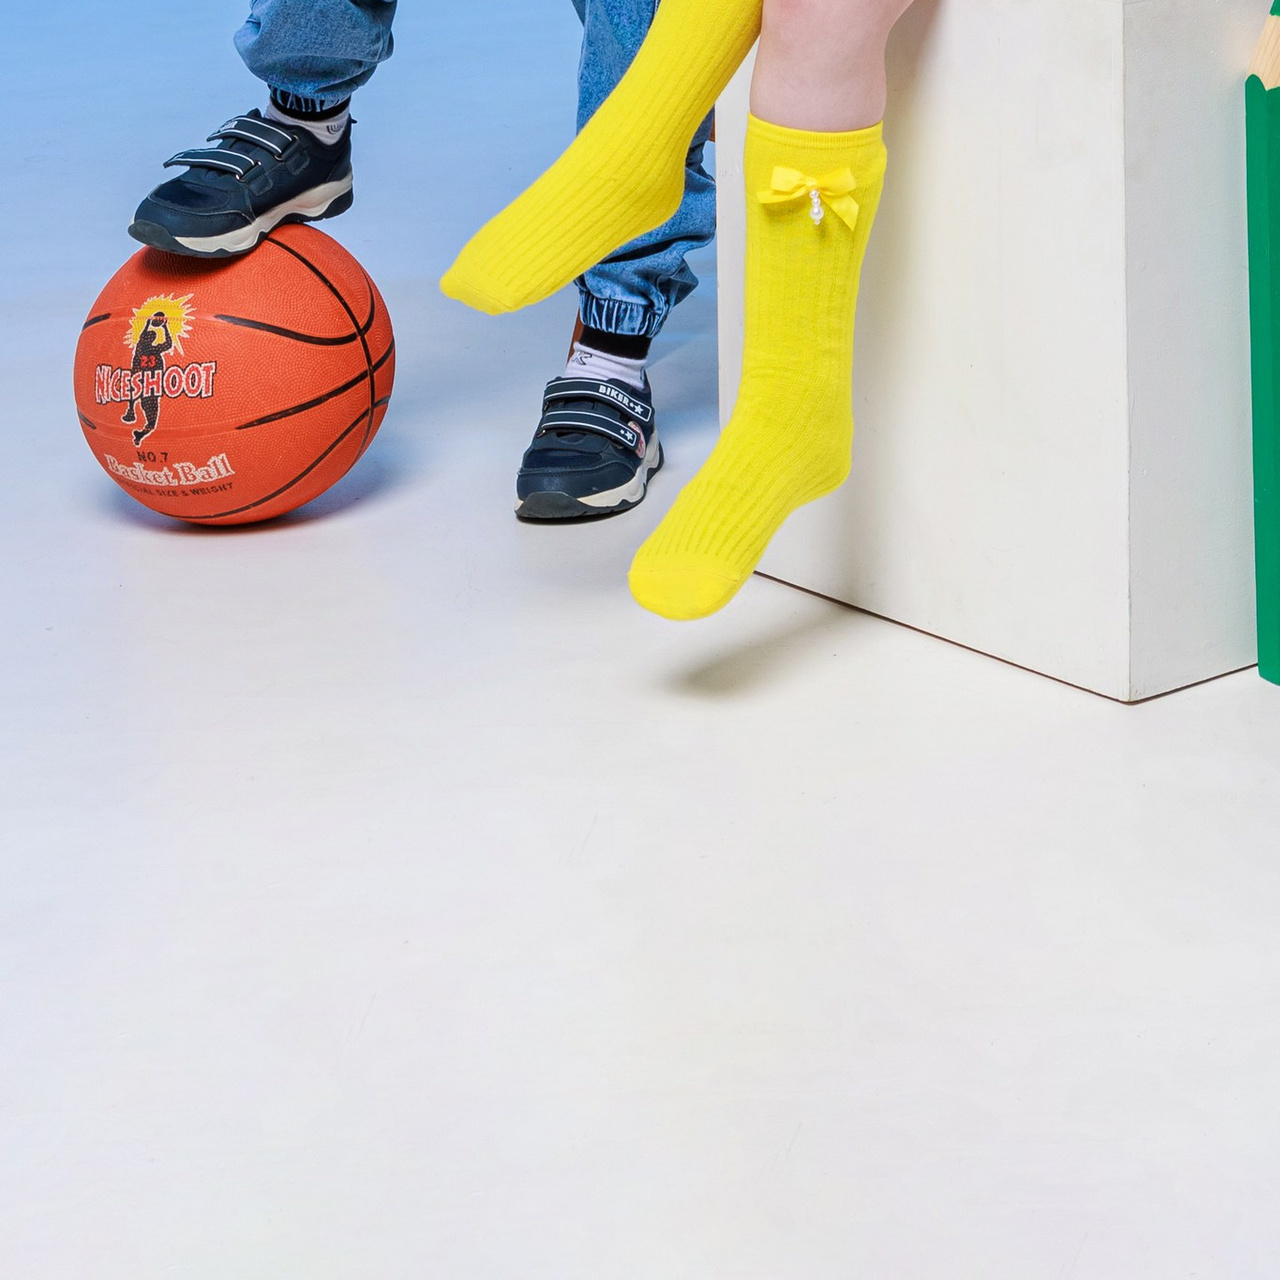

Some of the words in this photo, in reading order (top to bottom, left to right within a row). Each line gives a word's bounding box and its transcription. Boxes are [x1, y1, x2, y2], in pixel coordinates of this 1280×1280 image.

[140, 355, 157, 368] 23
[95, 361, 217, 405] NICESHOOT
[599, 385, 630, 406] BIKER
[104, 453, 178, 487] Basket
[173, 453, 235, 485] Ball
